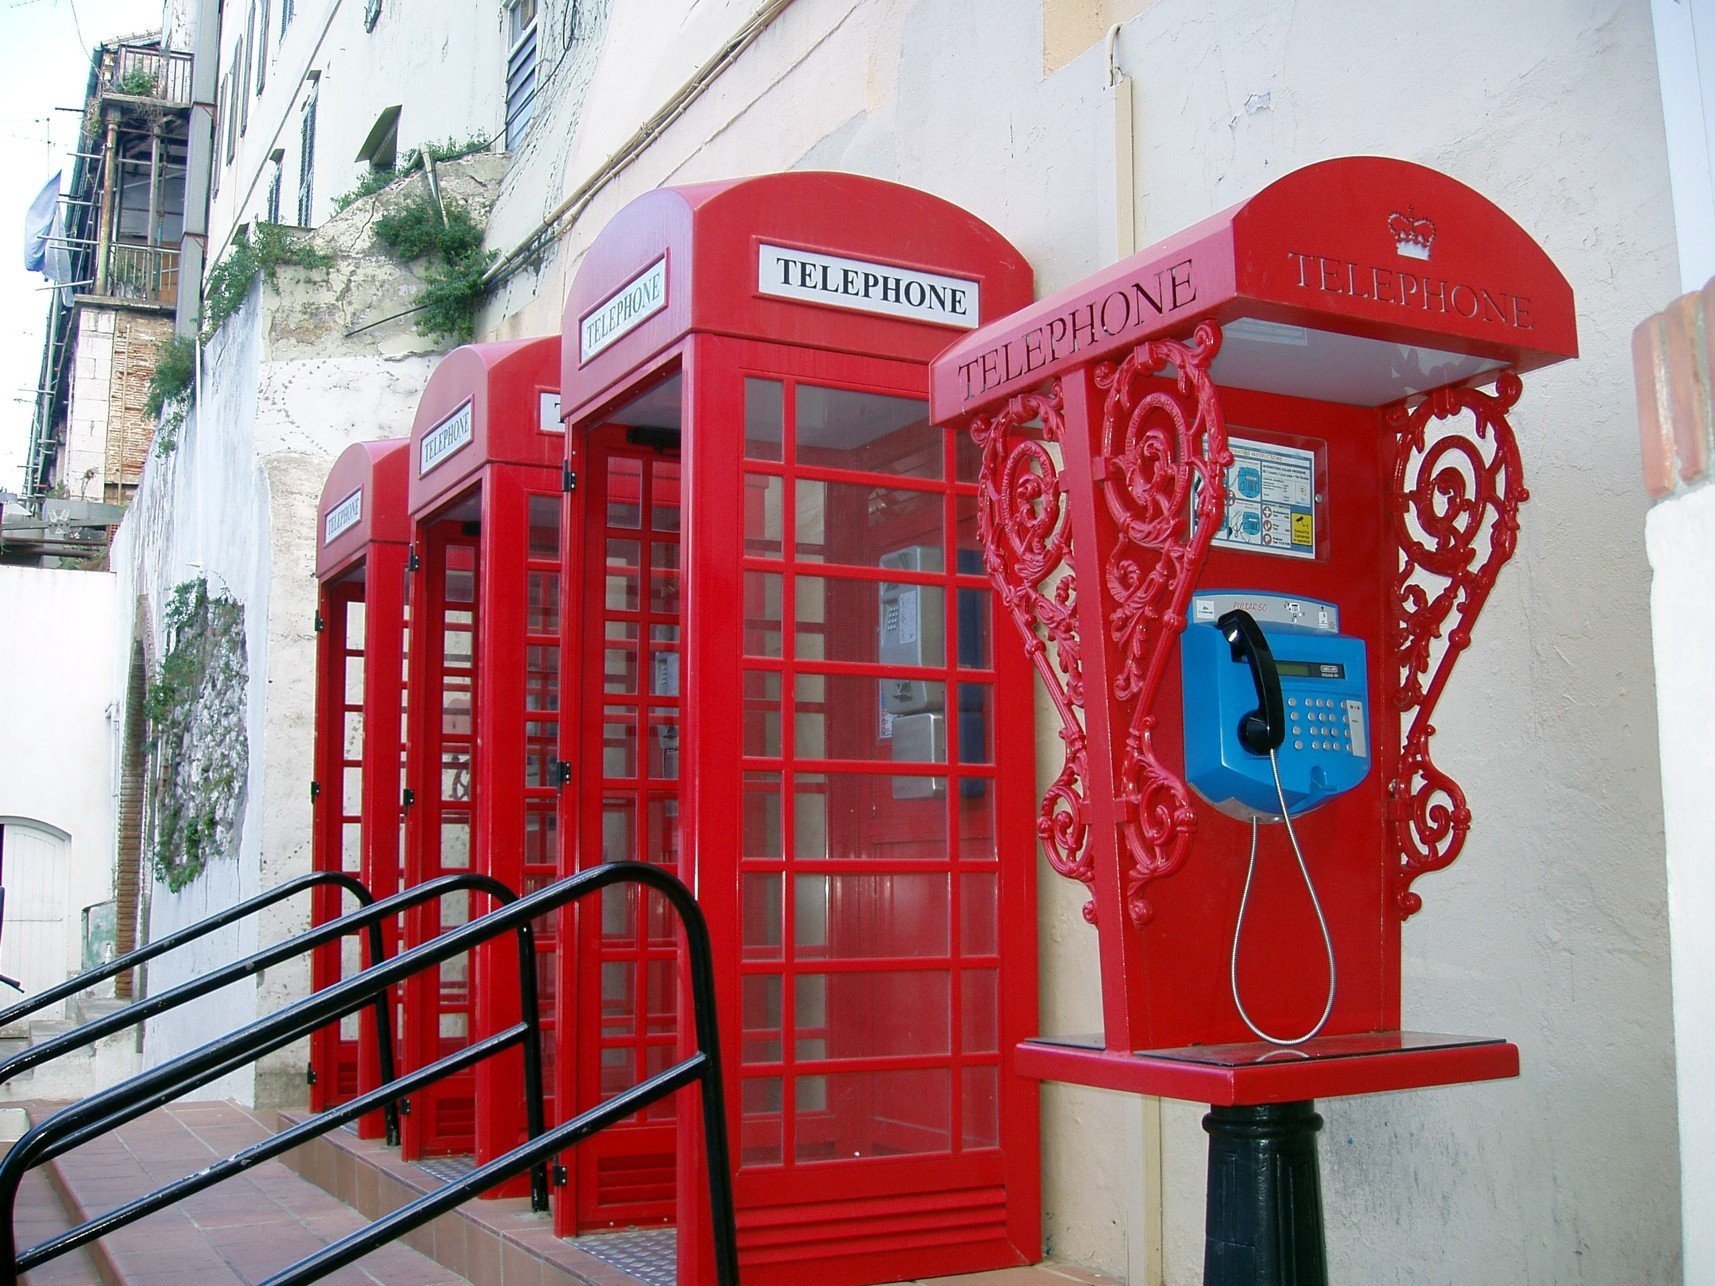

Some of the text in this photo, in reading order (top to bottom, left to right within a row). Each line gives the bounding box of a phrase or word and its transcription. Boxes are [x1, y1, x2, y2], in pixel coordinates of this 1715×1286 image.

[586, 272, 661, 348] TELEPHONE
[776, 258, 967, 316] TELEPHONE
[1288, 252, 1534, 330] TELEPHONE
[958, 258, 1198, 402] TELEPHONE
[424, 412, 470, 463] TELEPHONE
[327, 502, 360, 529] TELEPHONE
